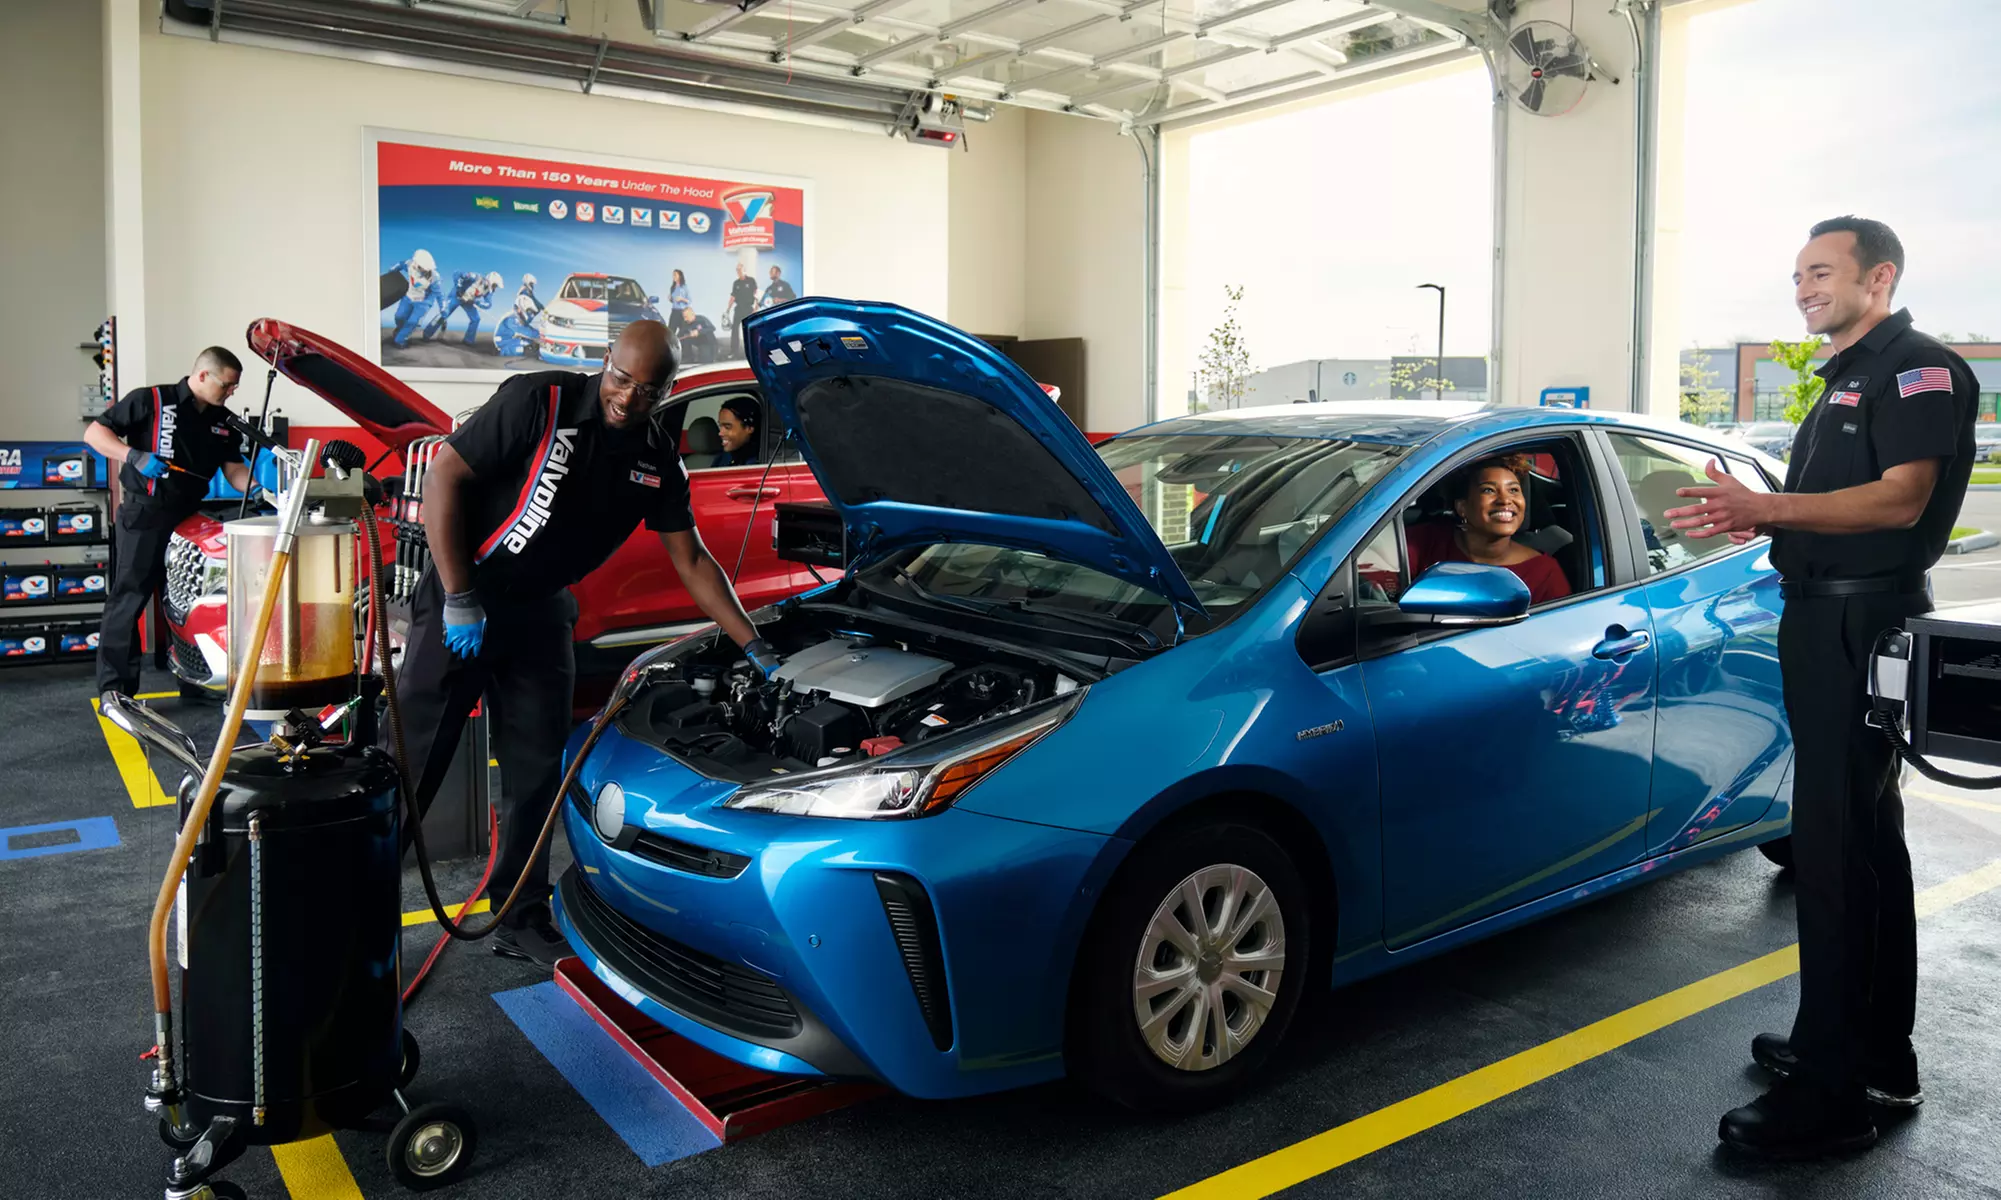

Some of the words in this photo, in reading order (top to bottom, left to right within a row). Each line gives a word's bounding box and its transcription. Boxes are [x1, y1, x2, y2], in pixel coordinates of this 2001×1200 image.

[449, 160, 493, 175] More
[497, 165, 537, 180] Than
[541, 171, 571, 183] 150
[575, 174, 619, 189] Years
[621, 180, 657, 193] Under
[660, 183, 681, 195] The
[683, 187, 714, 198] Hood
[160, 404, 177, 479] Valvoli
[502, 427, 578, 555] Valvoline
[1296, 719, 1345, 741] HYBRID
